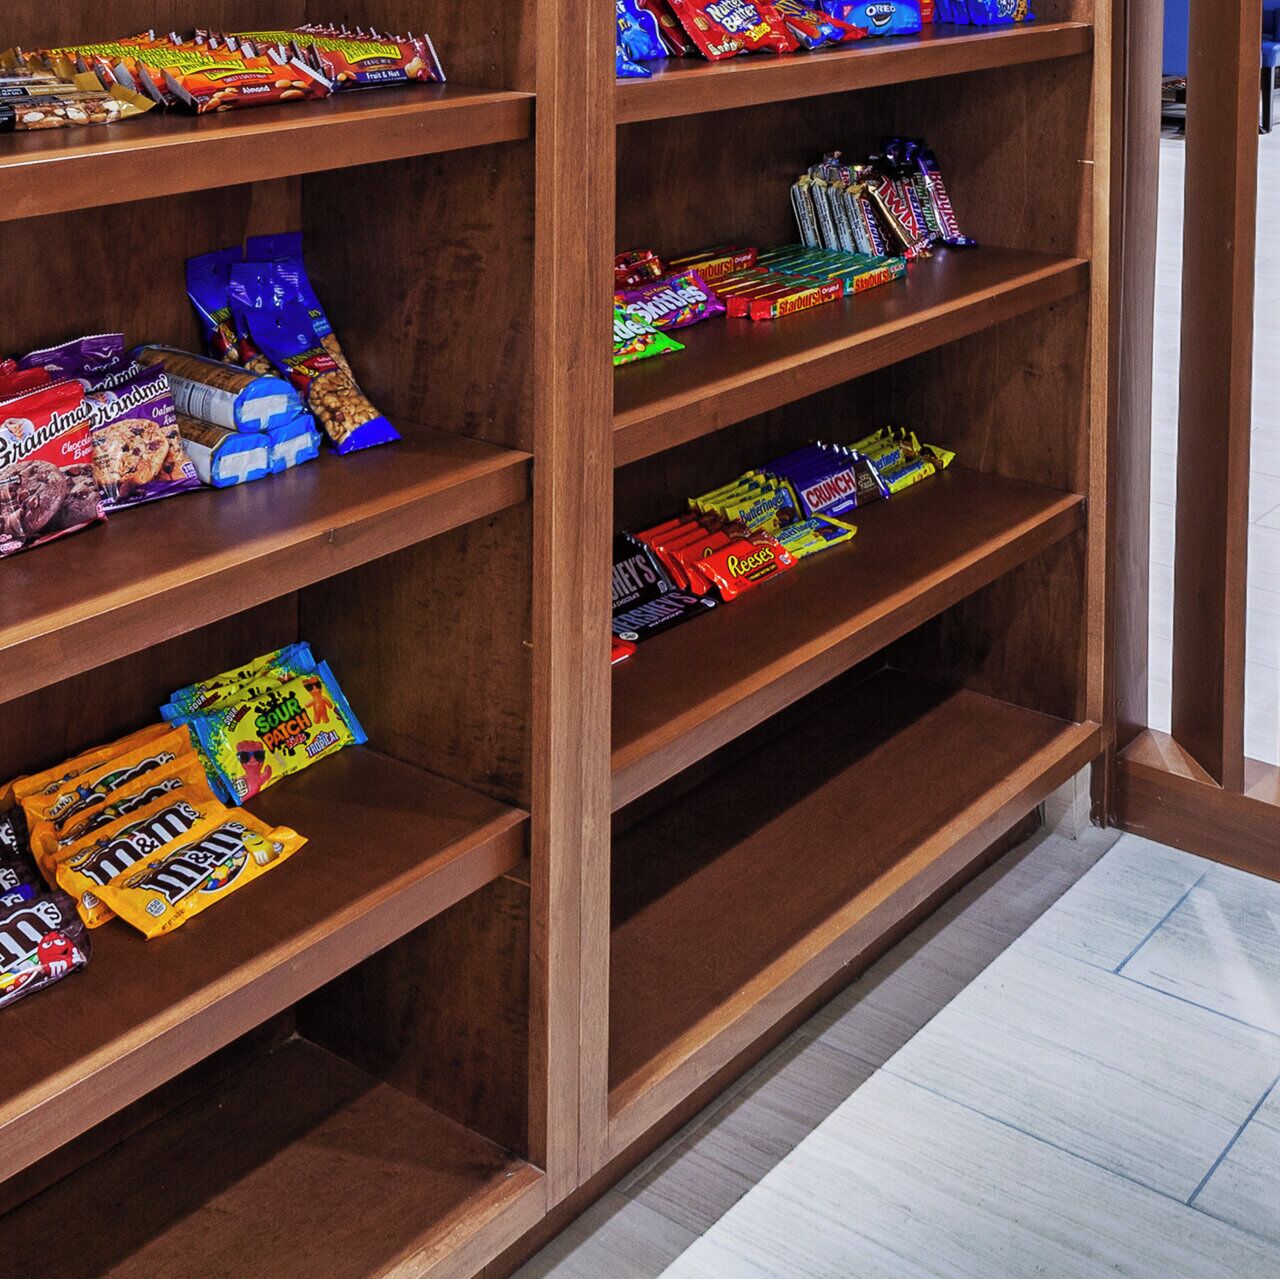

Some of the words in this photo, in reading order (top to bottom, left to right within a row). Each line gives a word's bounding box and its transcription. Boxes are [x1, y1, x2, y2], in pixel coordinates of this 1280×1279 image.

[721, 4, 756, 32] Butter
[865, 4, 896, 18] OREO
[242, 84, 271, 95] Almond
[366, 72, 381, 81] Fruit
[389, 70, 401, 79] Nut
[877, 175, 920, 241] TWIX
[625, 285, 708, 325] Skittles
[805, 472, 855, 509] CRUNCH
[727, 546, 776, 578] Reese's
[223, 706, 239, 727] SOUR
[254, 698, 302, 734] SOUR
[261, 708, 313, 751] PATCH
[305, 729, 341, 759] TROPICAL
[147, 900, 162, 913] 250
